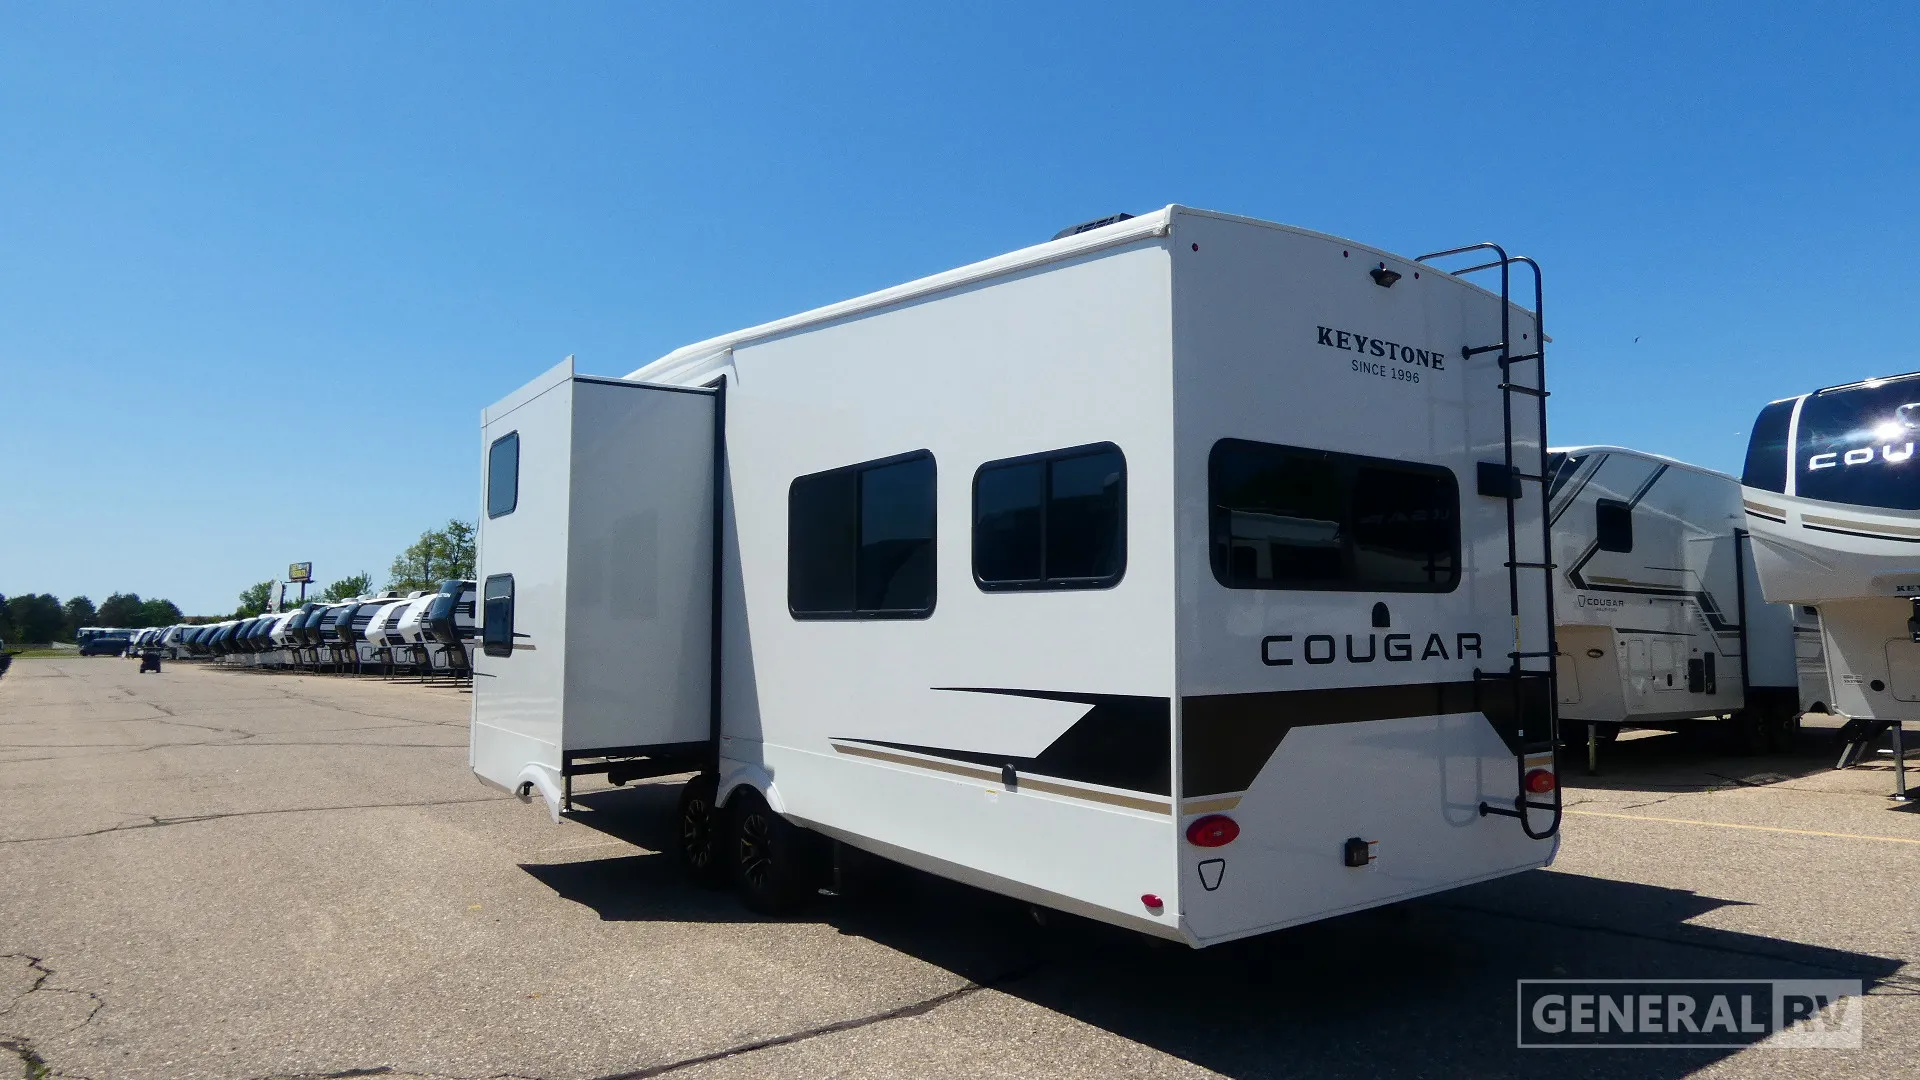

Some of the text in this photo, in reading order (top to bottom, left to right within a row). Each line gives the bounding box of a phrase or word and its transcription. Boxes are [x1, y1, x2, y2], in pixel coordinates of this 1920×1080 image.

[1316, 325, 1445, 371] KEYSTONE
[1351, 359, 1420, 384] SINCE 1996
[1587, 598, 1624, 607] COUGAR
[1261, 633, 1482, 667] COUGAR
